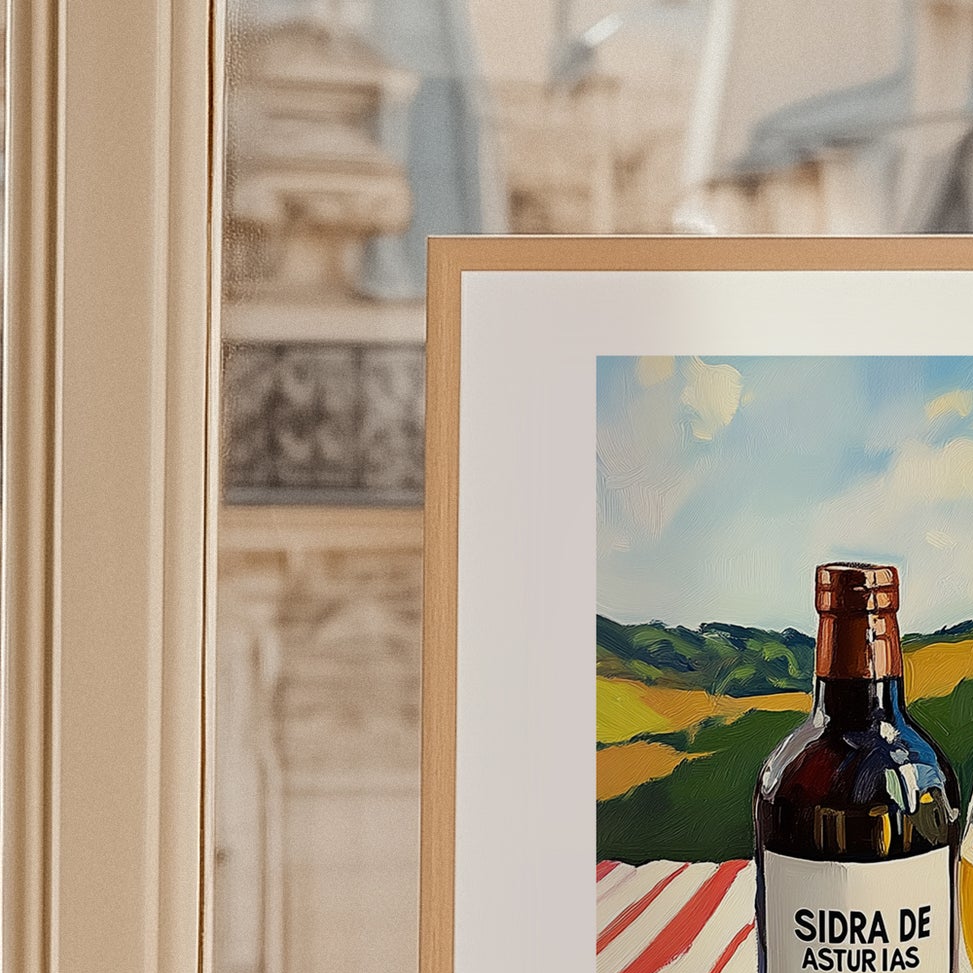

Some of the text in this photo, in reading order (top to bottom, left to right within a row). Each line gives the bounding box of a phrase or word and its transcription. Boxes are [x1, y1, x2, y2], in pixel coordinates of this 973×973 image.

[794, 905, 931, 945] SIDRA DE
[801, 946, 920, 973] ASTURIAS
